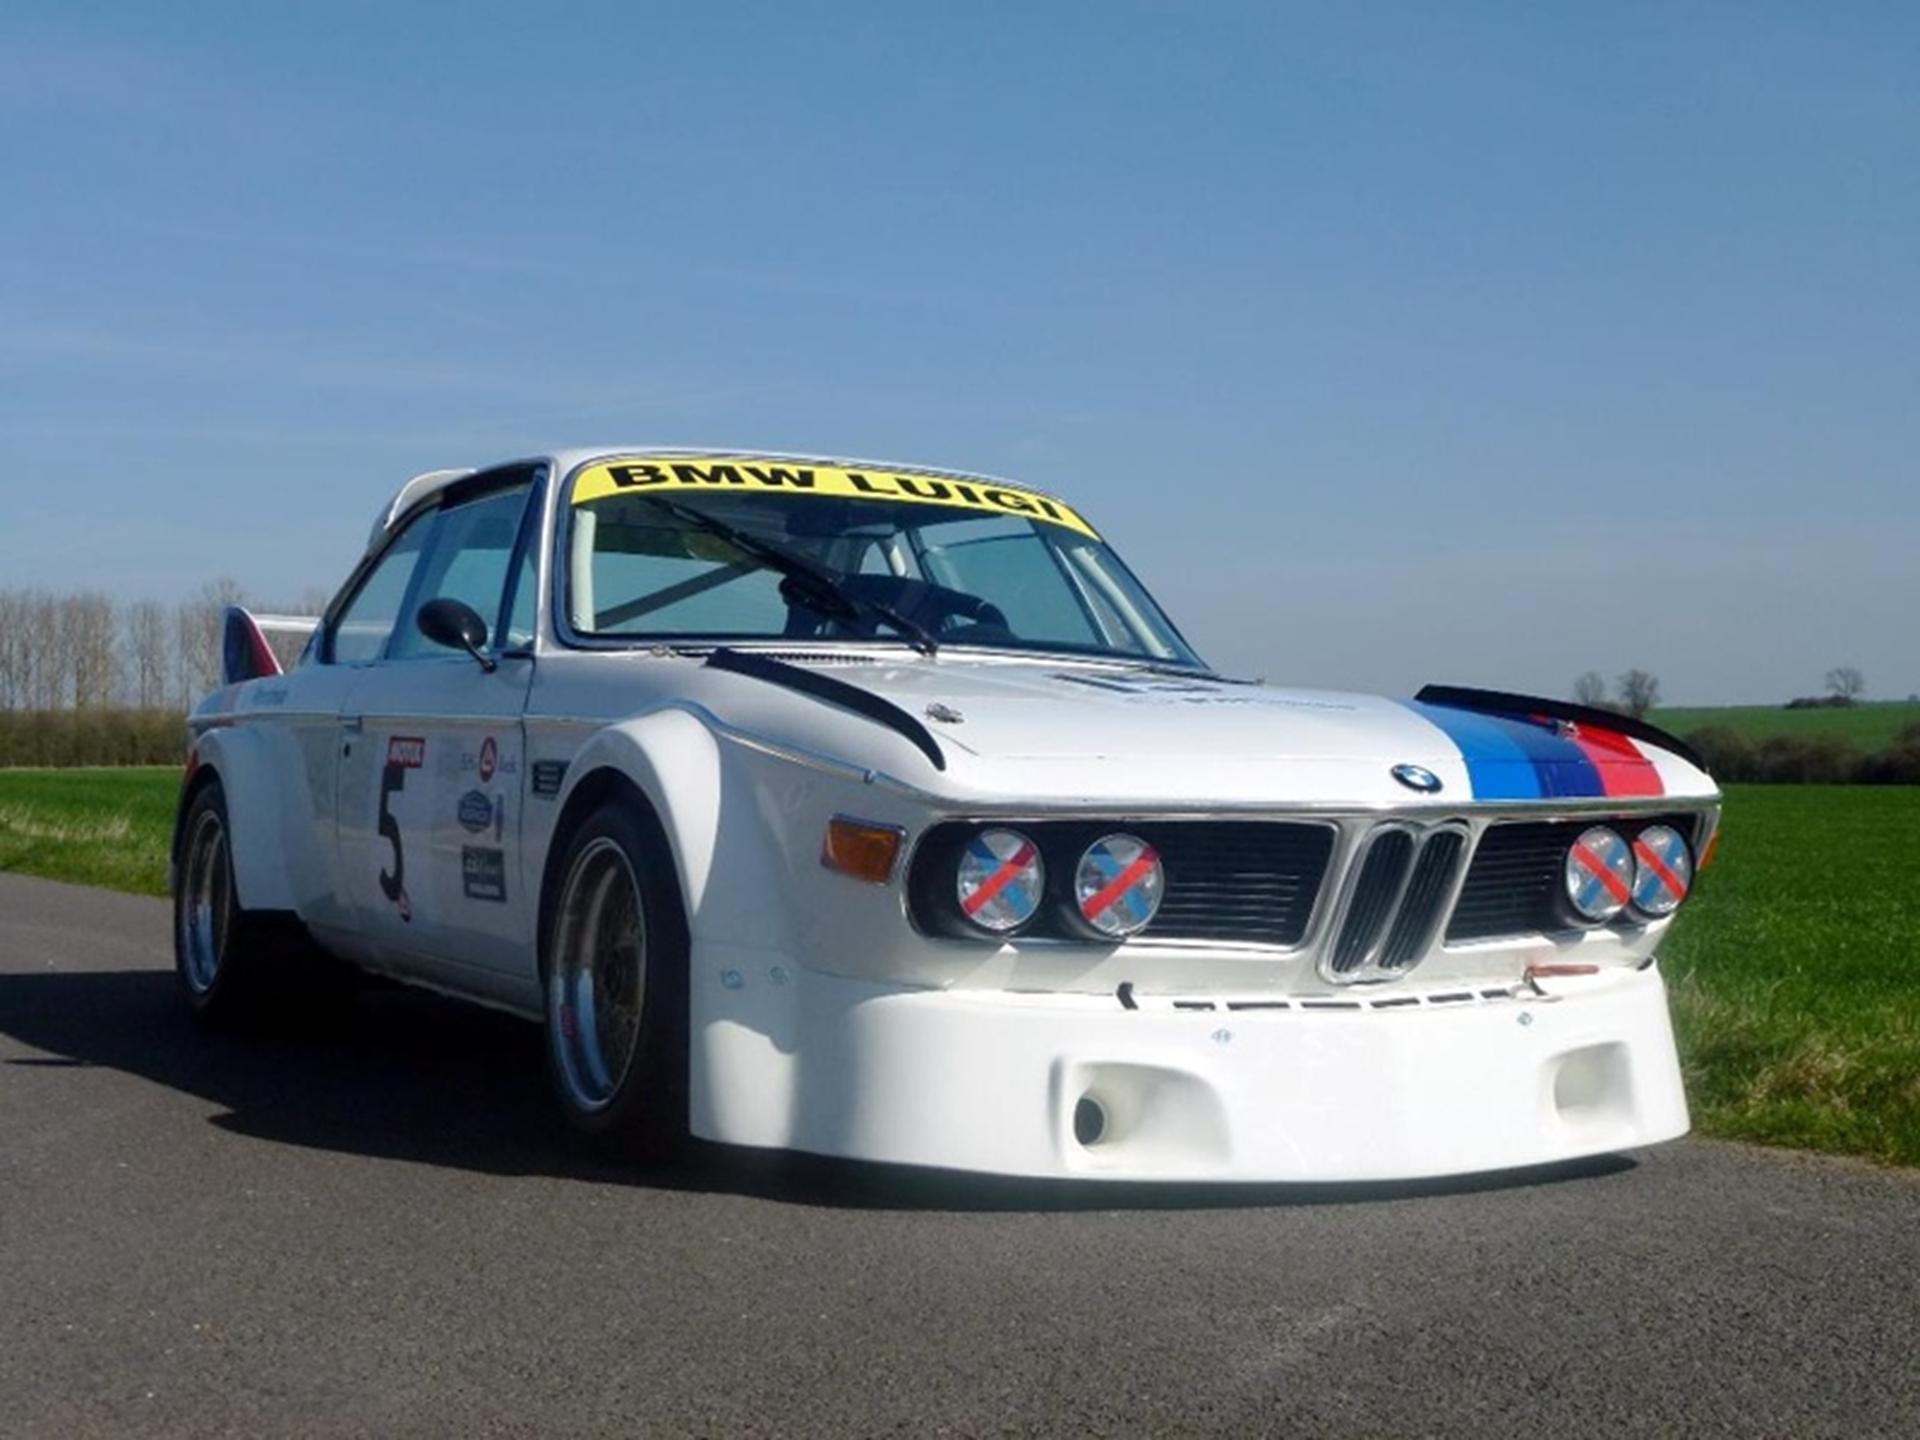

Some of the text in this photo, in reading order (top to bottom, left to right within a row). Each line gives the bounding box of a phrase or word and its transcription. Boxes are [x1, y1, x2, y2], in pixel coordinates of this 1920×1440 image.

[608, 464, 1063, 521] BMW LUIGI
[378, 766, 404, 902] 5
